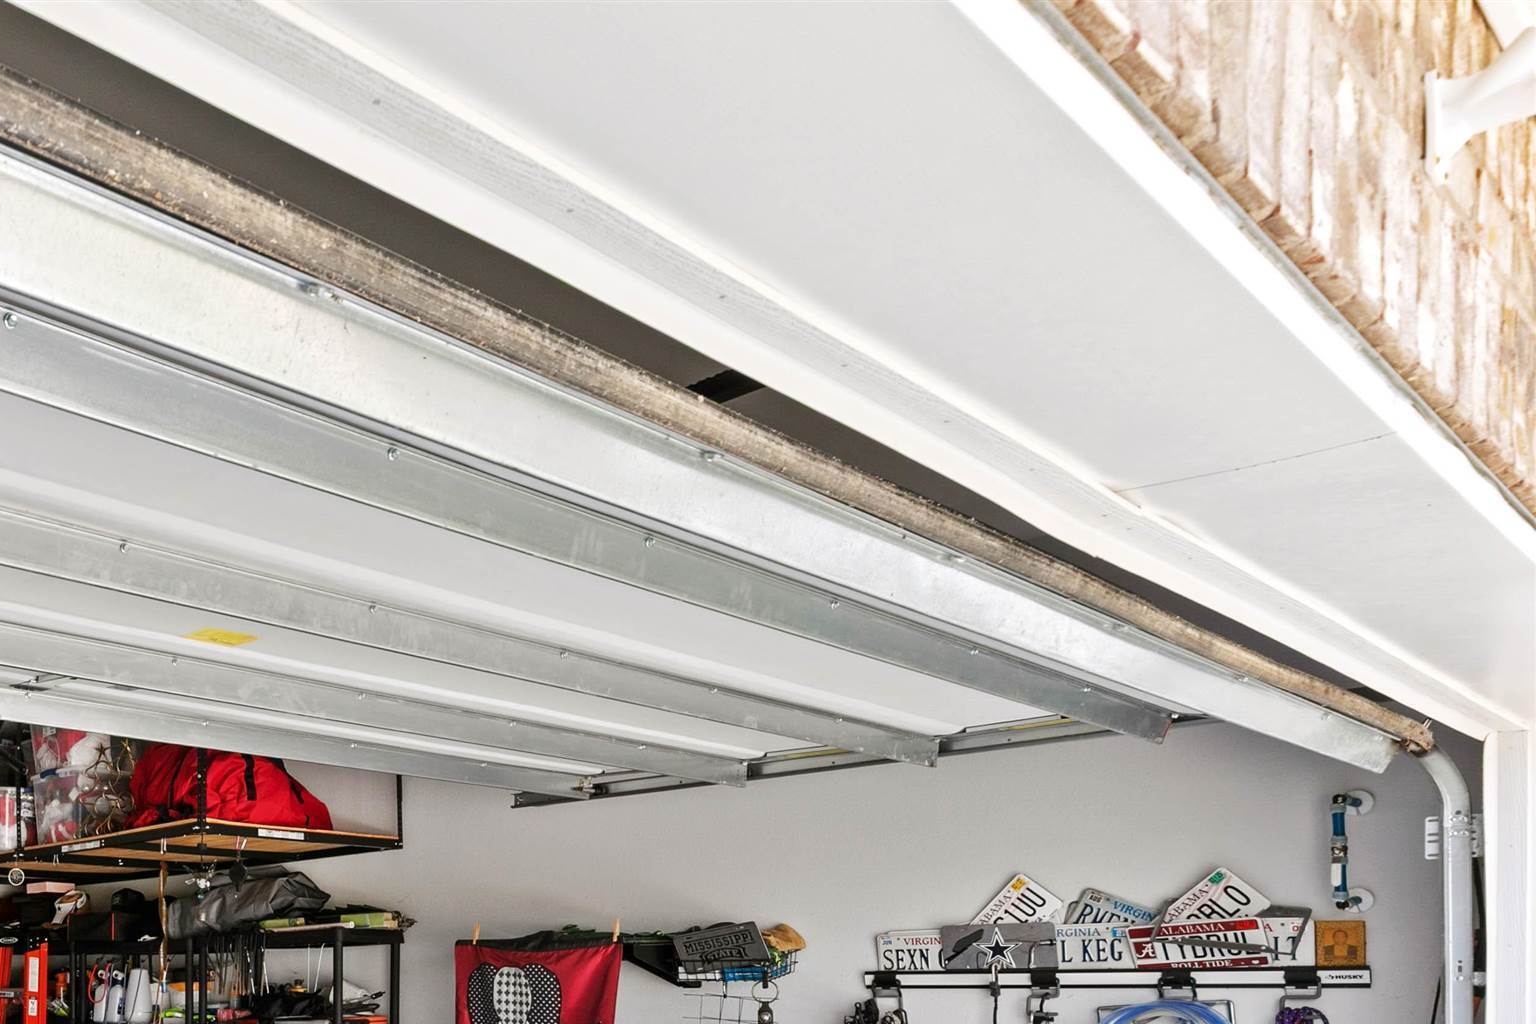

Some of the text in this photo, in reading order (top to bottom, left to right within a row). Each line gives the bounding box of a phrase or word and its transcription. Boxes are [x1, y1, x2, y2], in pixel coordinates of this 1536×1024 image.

[979, 892, 1013, 926] ABAMA
[1112, 900, 1153, 921] VIRGIN
[1056, 926, 1101, 939] RGINIA
[1159, 922, 1225, 936] ALABAMA
[683, 931, 754, 954] MISSISSIPPI
[903, 937, 942, 946] VIRGIN
[1081, 938, 1123, 963] KEG
[882, 948, 930, 971] SEXN
[1205, 958, 1234, 968] TIDE
